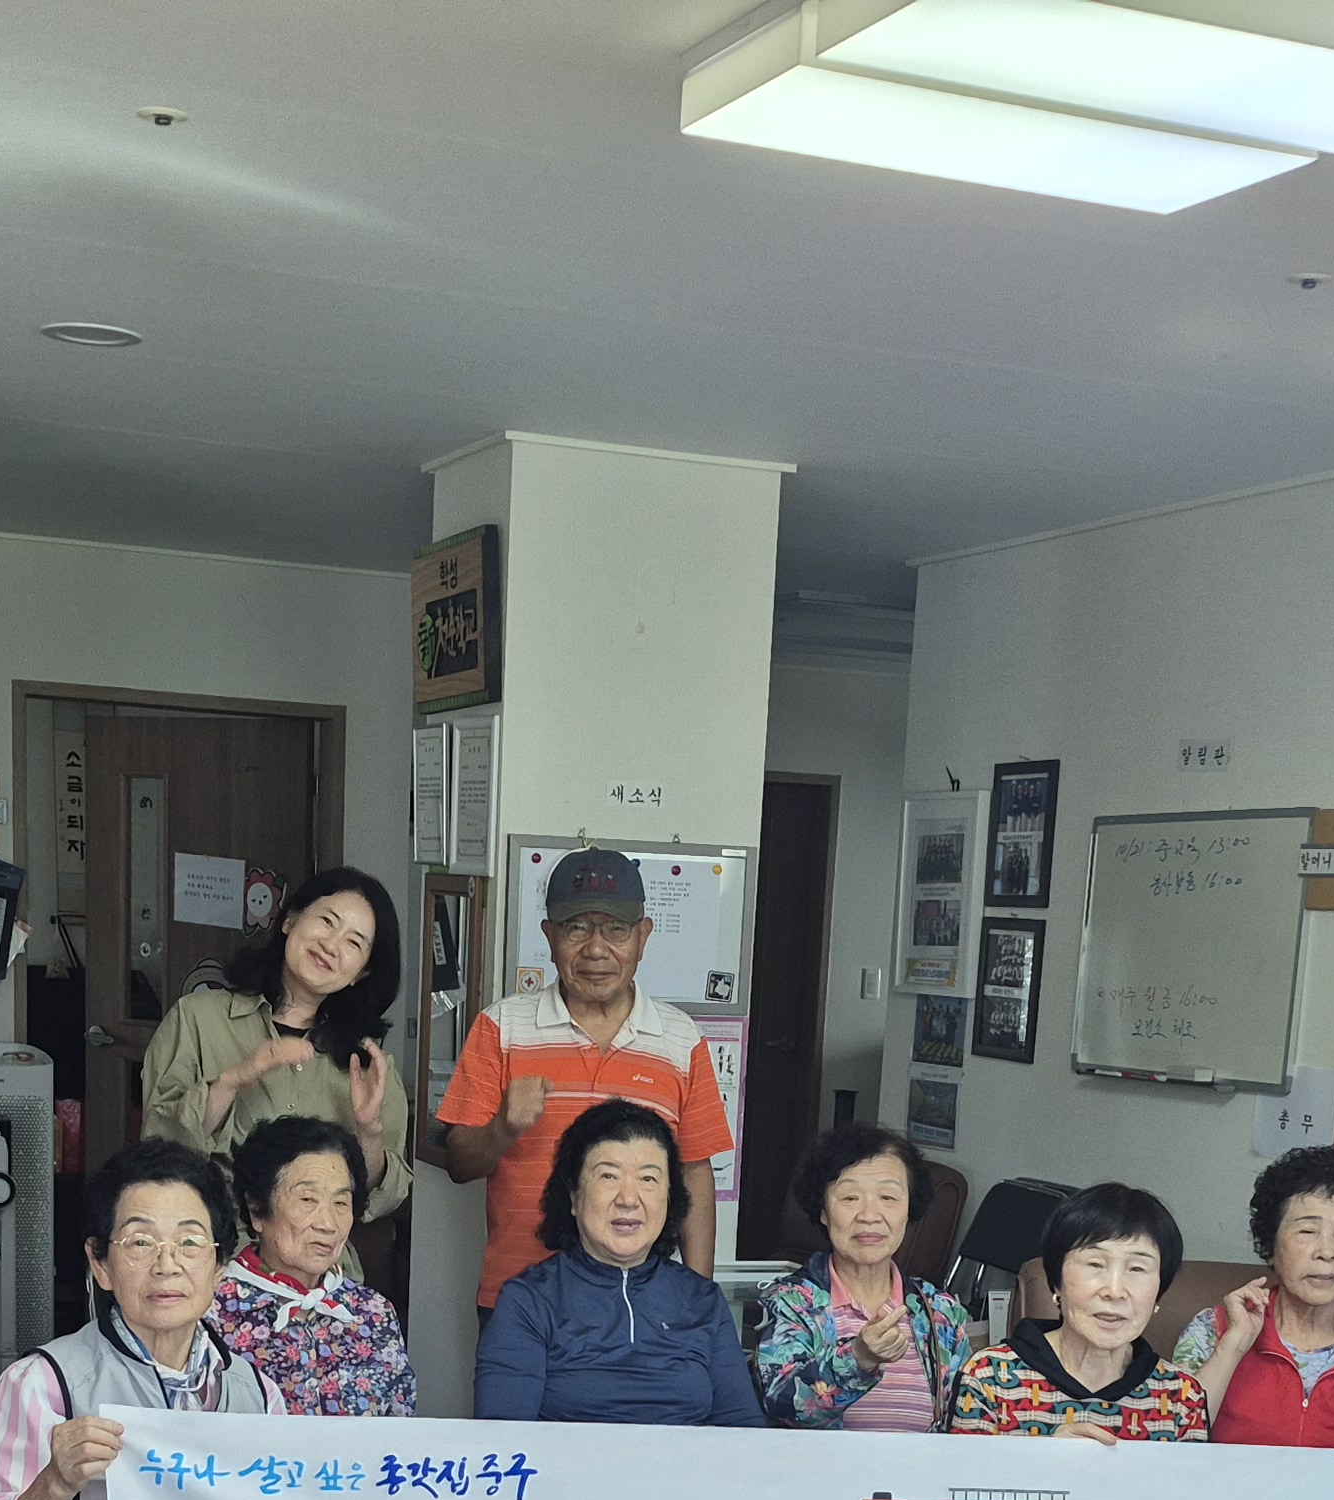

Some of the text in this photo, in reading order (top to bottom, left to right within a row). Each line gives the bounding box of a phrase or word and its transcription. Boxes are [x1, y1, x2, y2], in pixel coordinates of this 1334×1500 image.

[439, 556, 458, 589] 학성
[1182, 746, 1225, 766] 알림판
[609, 784, 662, 807] 새소식
[1300, 852, 1332, 872] 할머니
[1278, 1109, 1314, 1134] 총무
[139, 1449, 230, 1491] 누구나
[238, 1455, 304, 1494] 살고
[315, 1459, 366, 1492] 싶은
